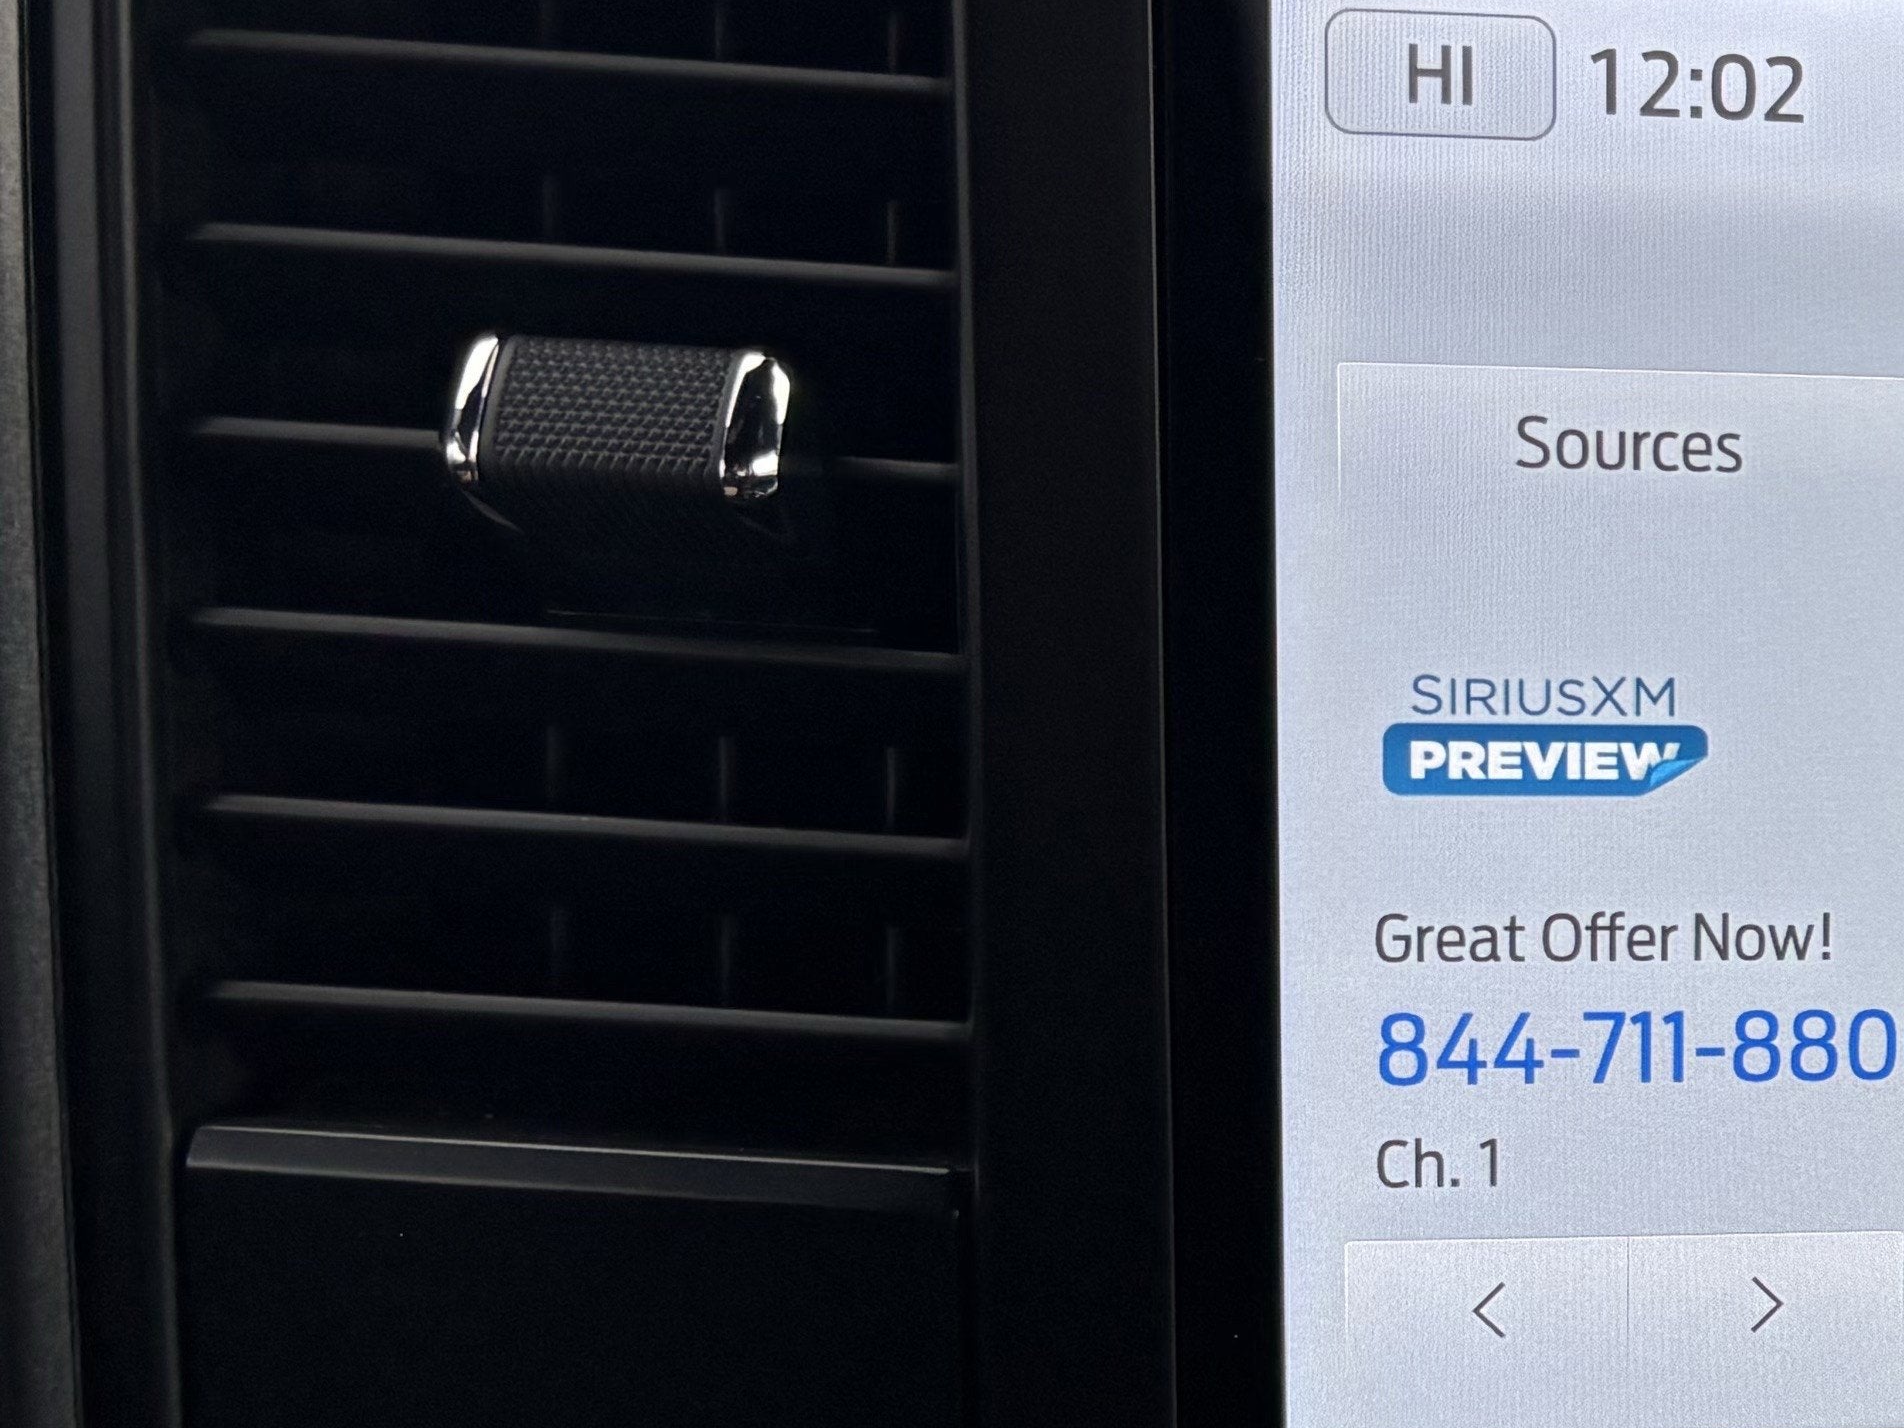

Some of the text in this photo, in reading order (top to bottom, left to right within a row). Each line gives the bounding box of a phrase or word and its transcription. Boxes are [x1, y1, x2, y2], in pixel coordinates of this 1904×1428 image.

[1406, 43, 1806, 124] HI 12:02
[1515, 414, 1744, 474] Sources
[1411, 673, 1676, 718] SIRIUSXM
[1410, 740, 1681, 781] PREVIEW
[1374, 910, 1832, 964] Great Offer Now!
[1376, 1137, 1502, 1190] Ch. 1
